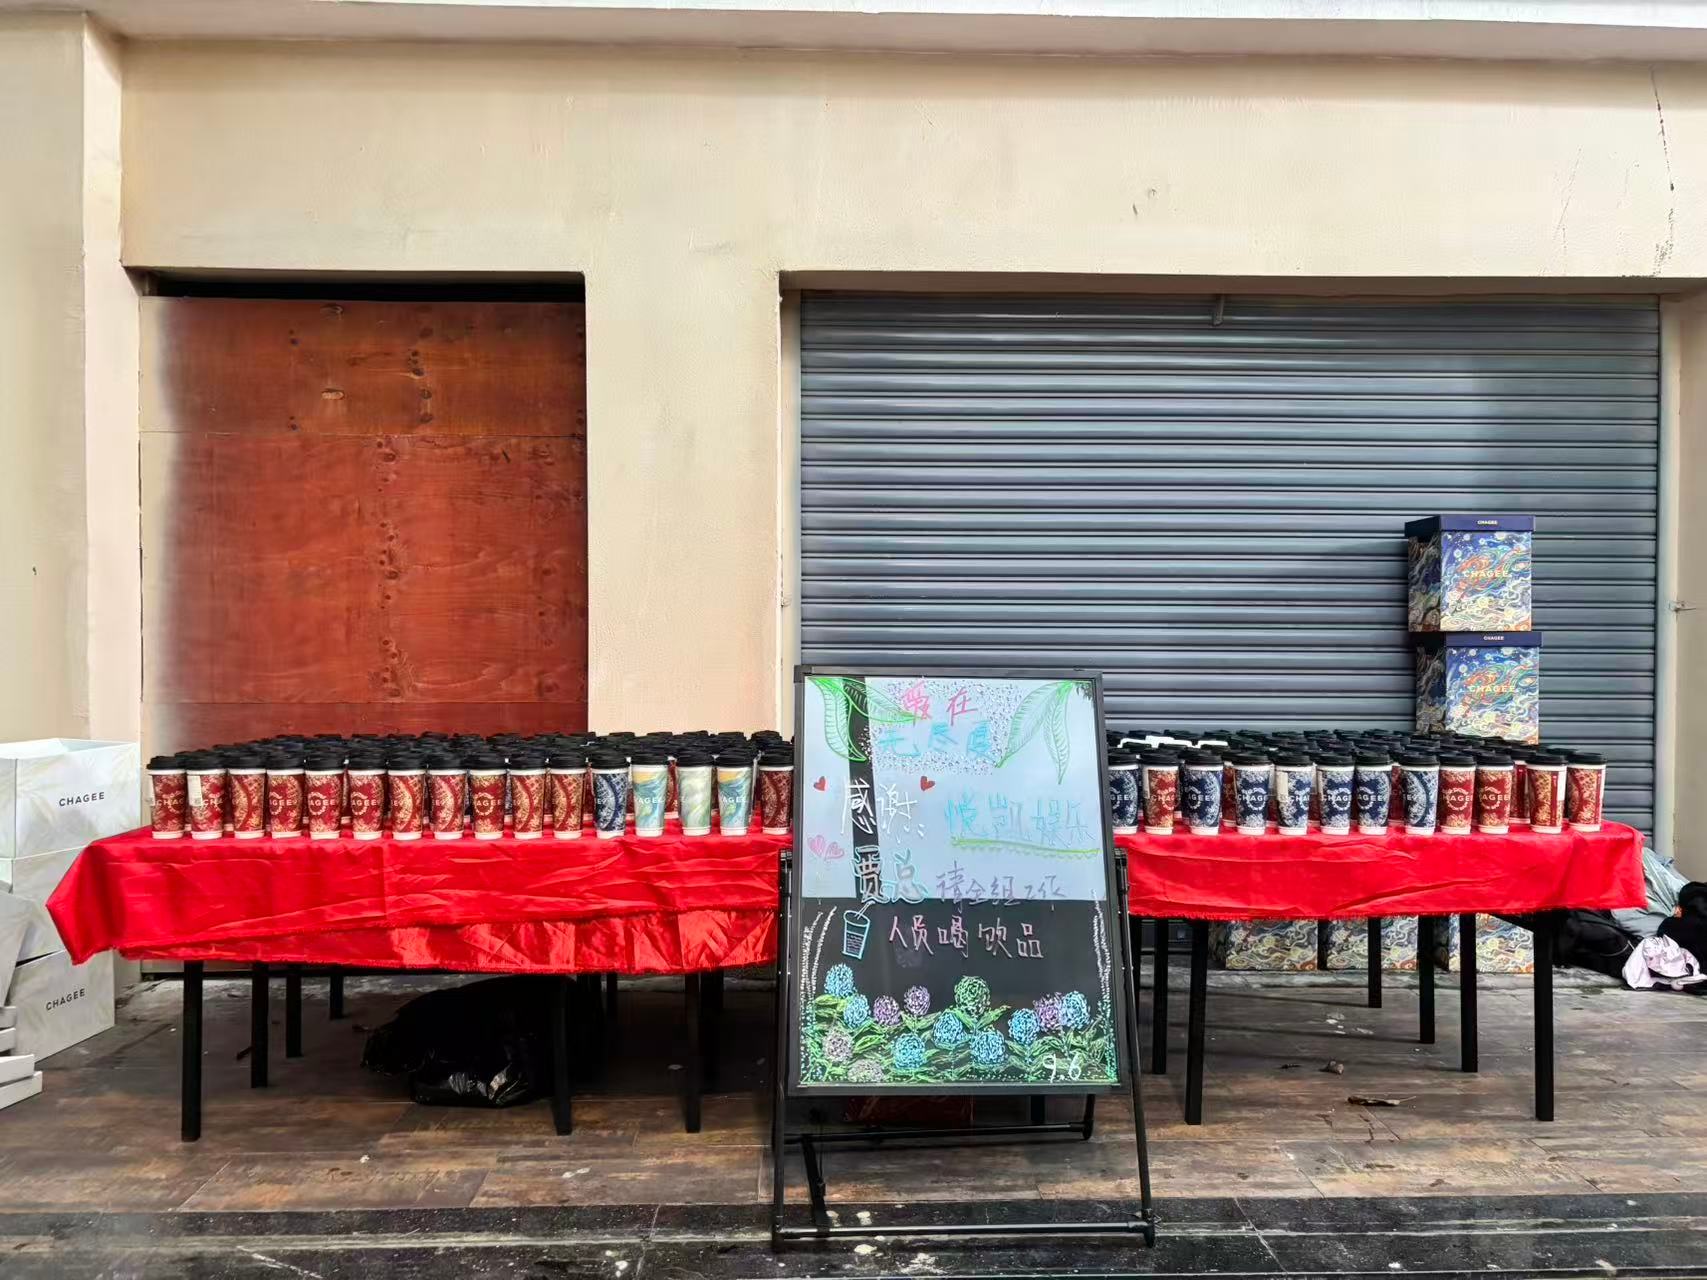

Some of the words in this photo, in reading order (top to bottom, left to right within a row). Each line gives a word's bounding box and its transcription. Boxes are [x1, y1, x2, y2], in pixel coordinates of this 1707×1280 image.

[1463, 570, 1509, 578] CHAGEE
[1468, 685, 1515, 693] CHAGEE
[58, 791, 105, 807] CHAGEE
[889, 913, 1045, 959] 人员喝饮品
[45, 988, 86, 1011] CHAGEE
